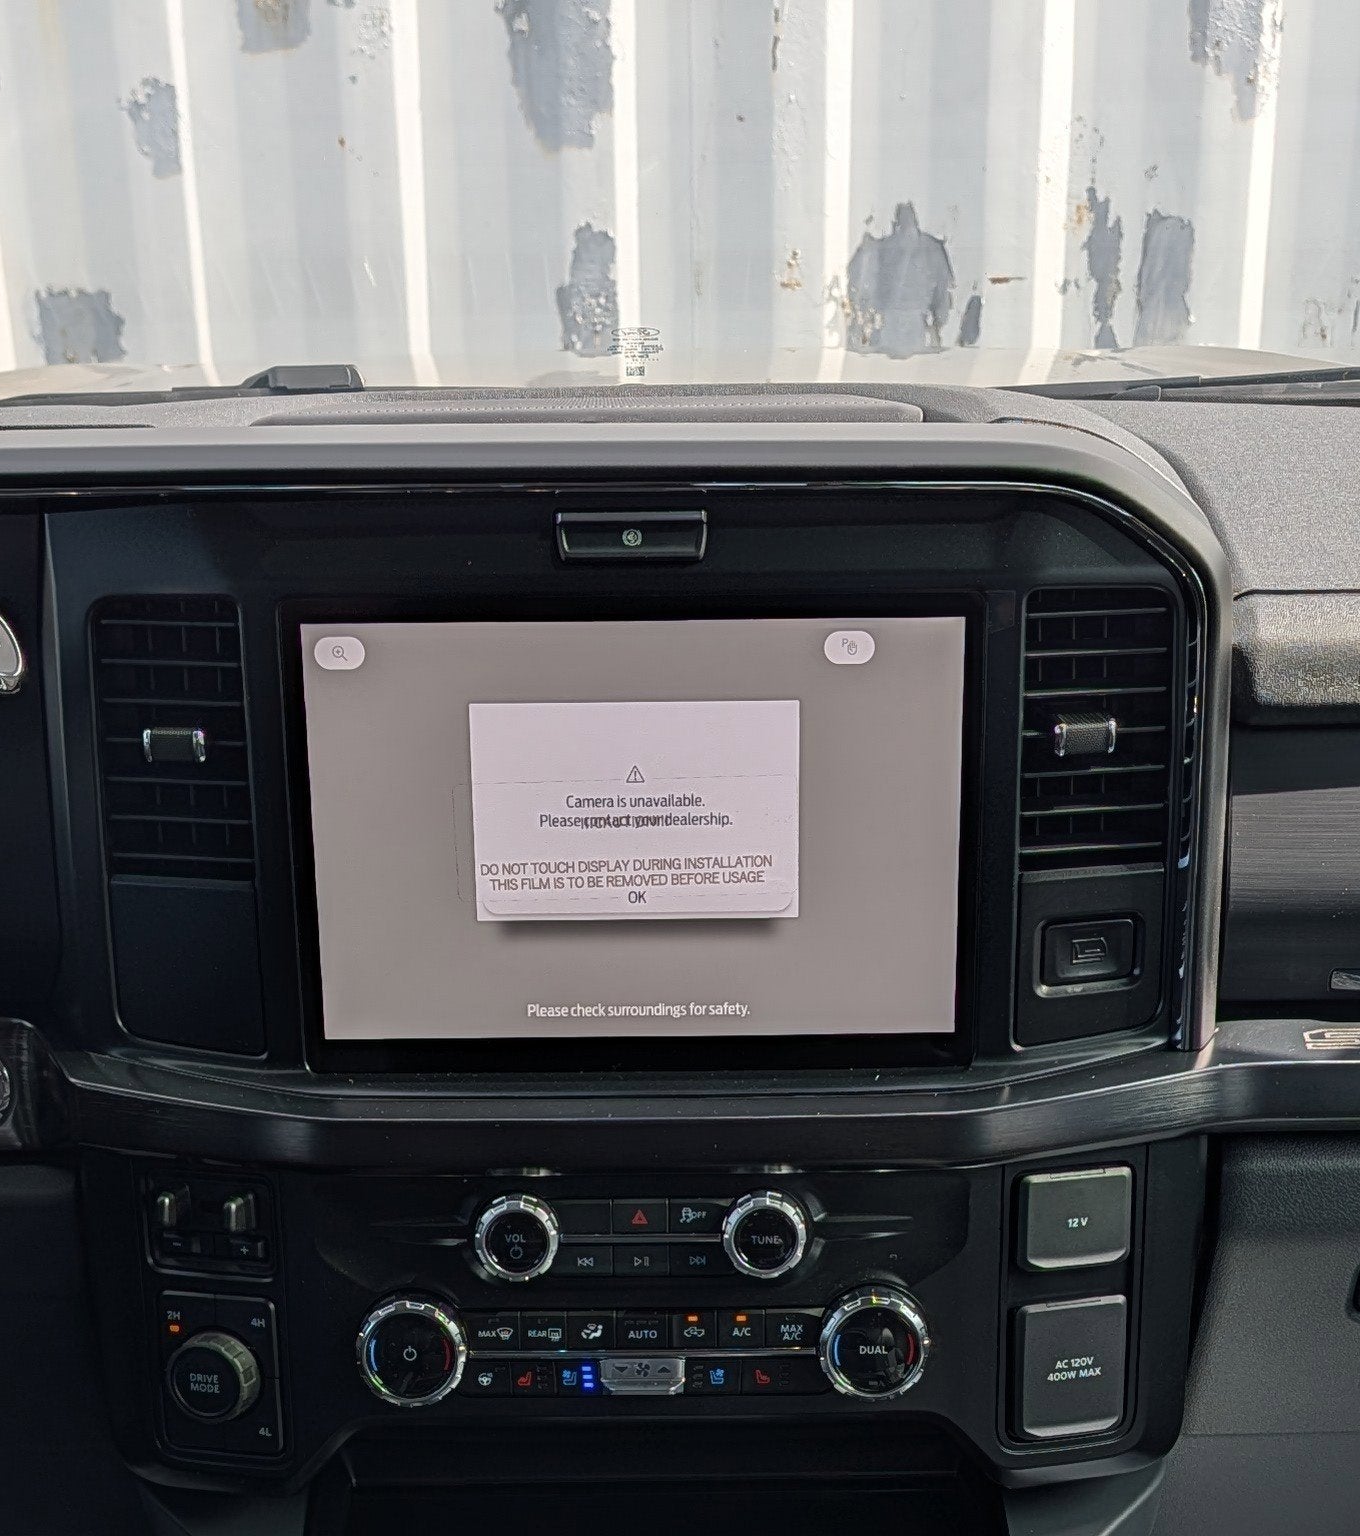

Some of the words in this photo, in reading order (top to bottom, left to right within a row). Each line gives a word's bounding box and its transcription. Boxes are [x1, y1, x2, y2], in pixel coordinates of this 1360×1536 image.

[565, 795, 614, 808] Camera
[617, 795, 626, 807] is
[629, 793, 705, 807] unavailable.
[540, 814, 581, 828] Please
[665, 812, 733, 828] dealership.
[480, 863, 499, 876] DO
[502, 863, 528, 875] NOT
[531, 861, 575, 874] TOUCH
[578, 860, 630, 873] DISPLAY
[633, 858, 681, 871] DURING
[684, 855, 772, 870] INSTALLATION
[490, 878, 518, 891] THIS
[521, 878, 551, 890] FILM
[554, 877, 564, 889] IS
[567, 876, 584, 889] TO
[587, 876, 603, 888] BE
[606, 874, 668, 887] REMOVED
[671, 872, 720, 885] BEFORE
[723, 870, 765, 884] USAGE
[628, 891, 647, 903] OK
[527, 1003, 569, 1017] Please
[571, 1003, 606, 1017] check
[608, 1003, 687, 1018] surroundings
[689, 1002, 707, 1016] for
[709, 1001, 750, 1017] safety.
[691, 1211, 707, 1219] OFF
[1068, 1218, 1079, 1228] 12
[1081, 1217, 1089, 1227] V
[504, 1234, 526, 1243] VOL
[751, 1235, 779, 1245] TUNE
[167, 1311, 181, 1320] 2H
[251, 1317, 266, 1328] 4H
[478, 1330, 497, 1338] MAX
[528, 1330, 547, 1338] REAR
[732, 1328, 751, 1337] A/C
[781, 1325, 803, 1333] MAX
[628, 1330, 658, 1340] AUTO
[783, 1332, 801, 1341] A/C
[859, 1345, 888, 1355] DUAL
[1055, 1359, 1069, 1370] AC
[1071, 1357, 1094, 1368] 120V
[190, 1373, 219, 1384] DRIVE
[1047, 1370, 1077, 1382] 400W
[1079, 1367, 1102, 1378] MAX
[191, 1383, 220, 1394] MODE
[259, 1427, 272, 1437] 4L
